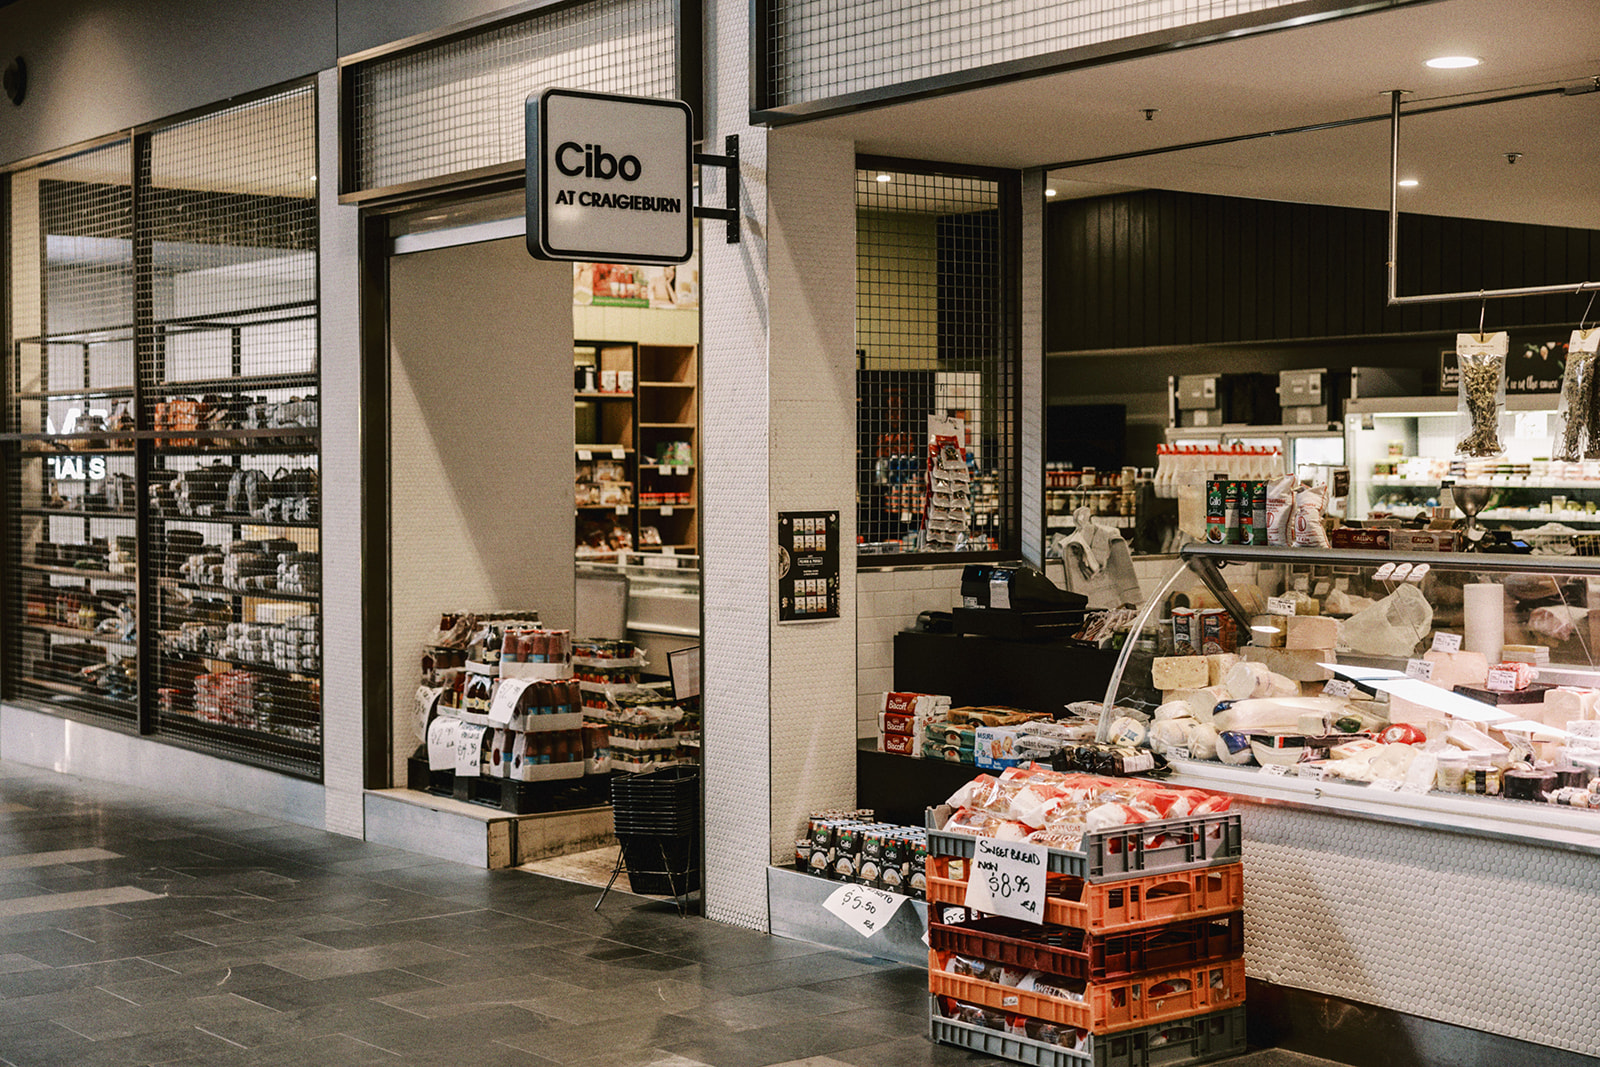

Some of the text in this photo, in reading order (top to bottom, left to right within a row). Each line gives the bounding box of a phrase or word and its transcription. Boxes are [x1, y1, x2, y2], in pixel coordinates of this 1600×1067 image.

[555, 141, 642, 182] Cibo
[555, 190, 681, 213] AT CRAIGIEBURN
[888, 699, 908, 711] Biscoff
[887, 720, 905, 732] Biscoff
[886, 740, 905, 752] Biscoff
[841, 889, 877, 915] $5.50
